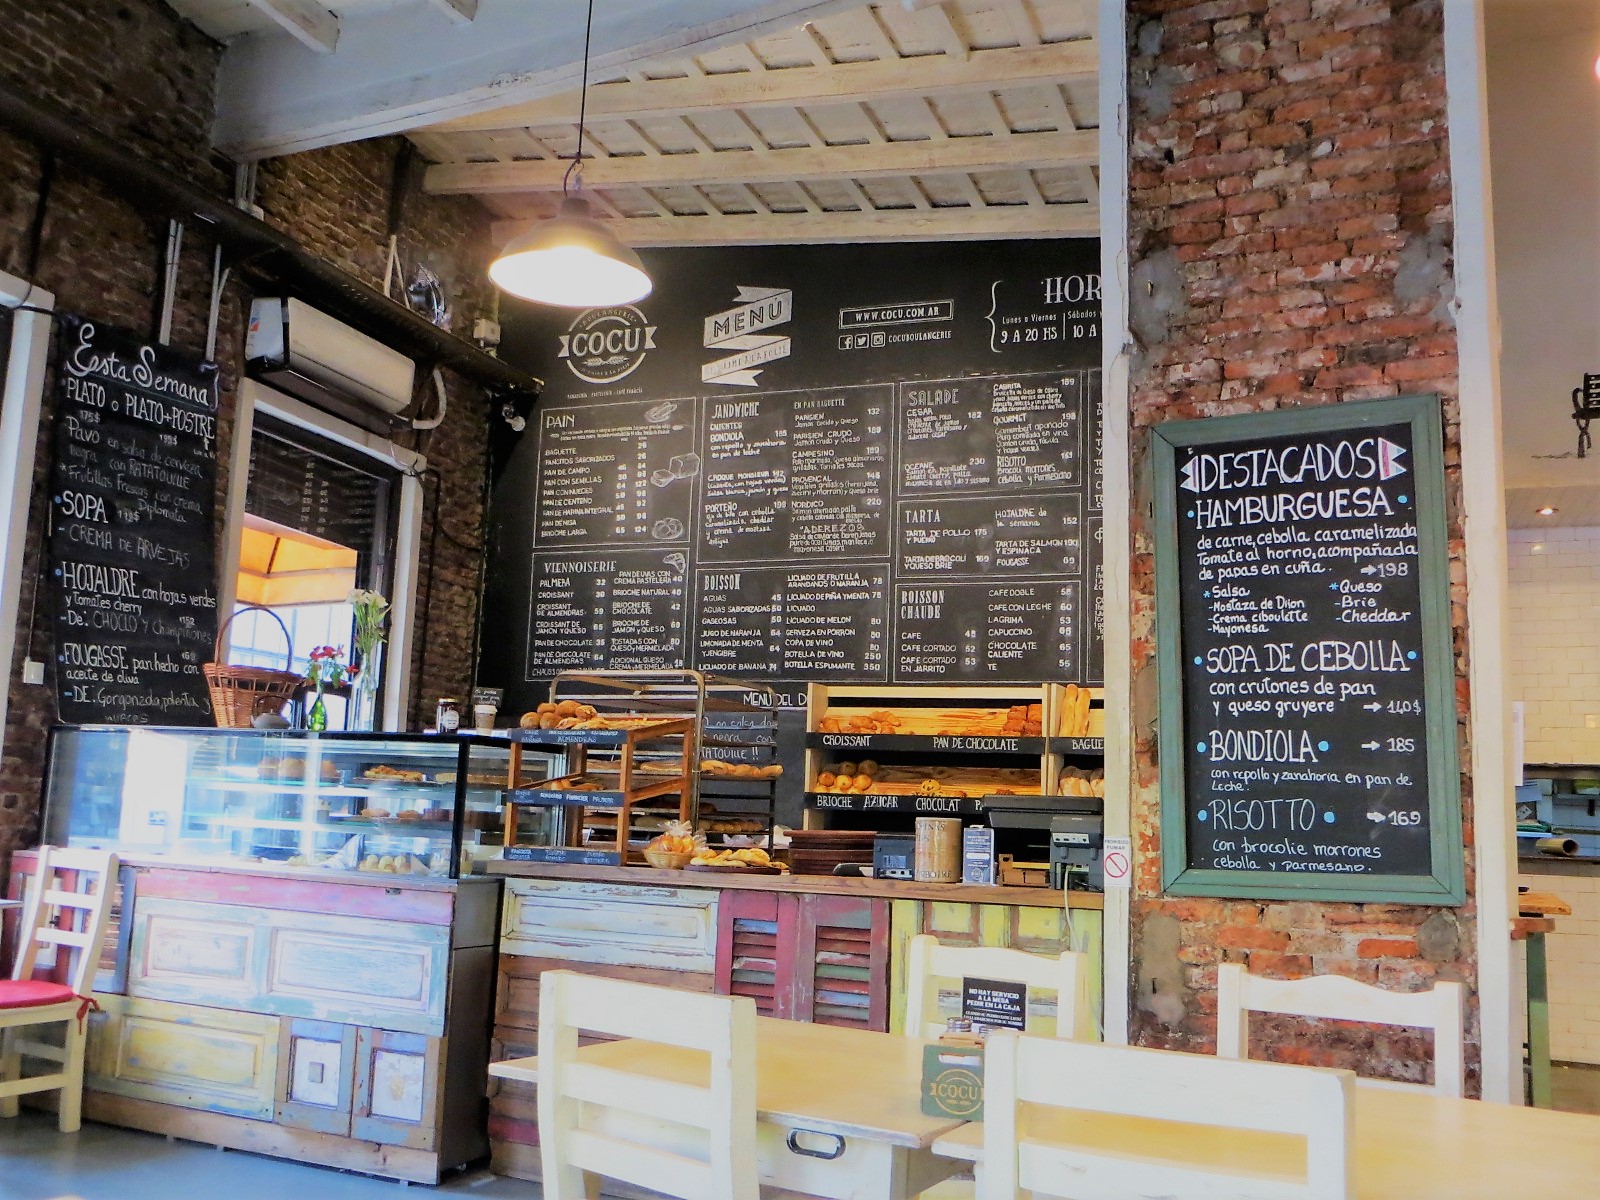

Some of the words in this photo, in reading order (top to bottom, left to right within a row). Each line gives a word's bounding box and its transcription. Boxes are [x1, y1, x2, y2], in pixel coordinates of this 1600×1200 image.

[713, 297, 783, 338] MENÚ
[855, 306, 940, 323] WWW.COCU.COM.AR
[1002, 315, 1022, 325] Lunes
[1031, 312, 1057, 322] Viernes
[1067, 309, 1097, 320] Sábados
[572, 327, 641, 357] COCU
[888, 330, 953, 343] COCUBOULANGERIE
[1001, 330, 1008, 344] 9
[1012, 330, 1021, 343] A
[1025, 328, 1039, 342] 20
[1042, 326, 1058, 341] HS
[1073, 324, 1084, 338] 10
[1089, 324, 1097, 338] A
[66, 323, 131, 382] Esta
[132, 346, 209, 406] Semana
[66, 377, 106, 407] PLATO
[908, 389, 960, 407] SALADE
[66, 415, 100, 443] Pavo
[546, 415, 575, 428] PAIN
[1201, 438, 1376, 492] DESTACADOS
[62, 490, 109, 523] SOPA
[1196, 487, 1394, 529] HAMBURGUESA
[905, 509, 941, 523] TARTA
[1062, 517, 1078, 525] 152
[69, 524, 113, 550] CREMA
[1197, 534, 1212, 550] de
[1314, 523, 1417, 543] caramelizada
[1197, 550, 1243, 566] Tomate
[1245, 546, 1260, 561] al
[1317, 541, 1418, 563] acompañada
[544, 560, 617, 574] VIENNOISERIE
[1199, 566, 1213, 581] de
[1218, 564, 1259, 583] papas
[1260, 563, 1280, 574] en
[1377, 563, 1408, 577] 198
[62, 561, 140, 598] HOJALDRE
[142, 588, 158, 600] con
[159, 582, 187, 606] hojas
[189, 589, 216, 608] verdes
[703, 573, 742, 590] BOISSON
[1339, 580, 1382, 595] Queso
[901, 590, 945, 604] BOISSON
[1212, 584, 1250, 599] Salsa
[65, 595, 72, 608] y
[114, 598, 142, 616] cherry
[901, 605, 942, 619] CHAUDE
[1260, 598, 1273, 610] de
[92, 610, 138, 632] CHOCLO
[64, 642, 129, 670] FOUGASSE
[133, 658, 152, 674] pan
[154, 652, 180, 673] hecho
[183, 663, 199, 674] con
[1206, 645, 1261, 674] SOPA
[1263, 643, 1296, 673] DE
[1301, 640, 1408, 672] CEBOLLA
[66, 669, 99, 681] aceite
[101, 670, 114, 682] de
[116, 670, 140, 684] oliva
[1209, 681, 1235, 695] con
[1239, 677, 1309, 695] crutones
[1314, 675, 1335, 695] de
[1340, 679, 1376, 701] pan
[743, 691, 772, 706] MENU
[1212, 701, 1220, 716] y
[1228, 701, 1271, 717] queso
[1275, 700, 1335, 718] gruyere
[822, 735, 872, 747] CROISSANT
[933, 737, 949, 749] PAN
[951, 737, 964, 749] DE
[965, 738, 1018, 751] CHOCOLATE
[1208, 729, 1318, 763] BONDIOLA
[1386, 737, 1415, 752] 185
[1211, 768, 1230, 779] con
[1233, 767, 1270, 783] repollo
[1272, 772, 1280, 785] y
[1281, 769, 1340, 784] zanahoria
[1345, 773, 1361, 784] en
[1366, 775, 1392, 789] pan
[1395, 771, 1412, 786] de
[816, 795, 852, 808] BRIOCHE
[863, 795, 899, 808] AZUCAR
[915, 798, 960, 812] CHOCOLAT
[1208, 798, 1316, 831] RISOTTO
[1387, 810, 1421, 825] 169
[1213, 838, 1236, 851] con
[1313, 843, 1382, 859] morrones
[1214, 855, 1260, 869] cebolla
[1269, 861, 1277, 871] y
[991, 990, 1020, 999] SERVICIO
[938, 1084, 978, 1100] COCU
